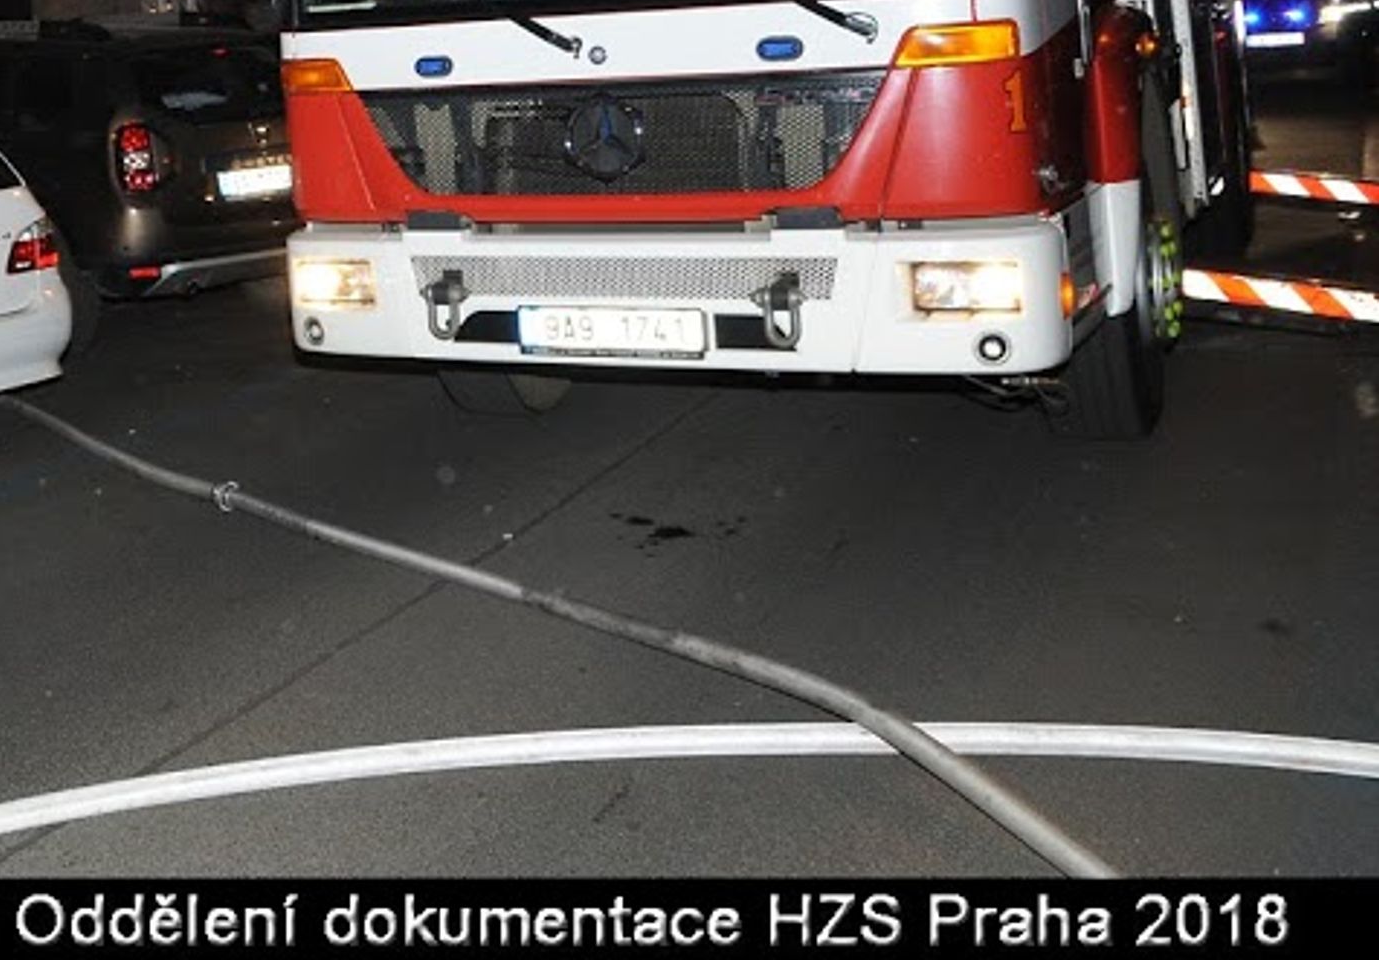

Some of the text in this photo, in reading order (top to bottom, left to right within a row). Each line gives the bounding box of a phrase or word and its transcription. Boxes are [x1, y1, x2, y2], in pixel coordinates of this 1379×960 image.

[1004, 70, 1027, 133] 1
[545, 315, 685, 341] 9A9 1741
